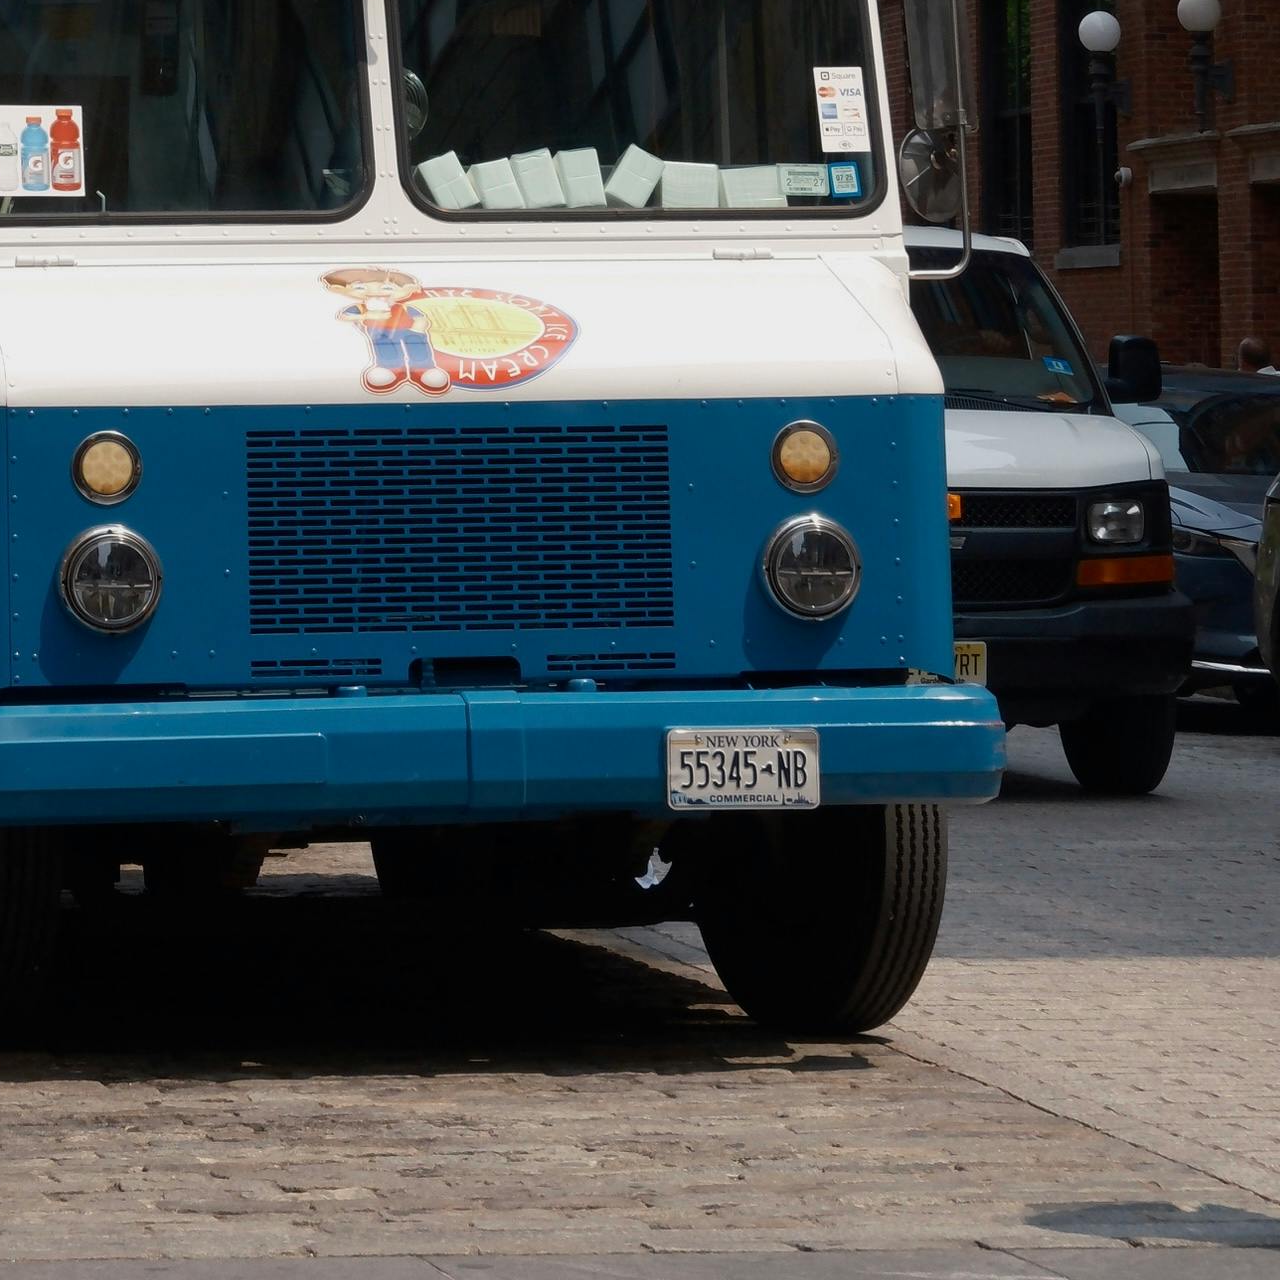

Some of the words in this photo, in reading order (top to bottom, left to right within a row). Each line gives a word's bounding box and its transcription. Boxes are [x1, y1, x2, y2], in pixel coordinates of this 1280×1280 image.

[839, 88, 862, 97] VISA
[545, 322, 568, 341] ICE
[459, 344, 549, 382] CREAM
[706, 734, 738, 749] NEW
[741, 734, 780, 749] YORK
[709, 793, 779, 803] COMMERCIAL
